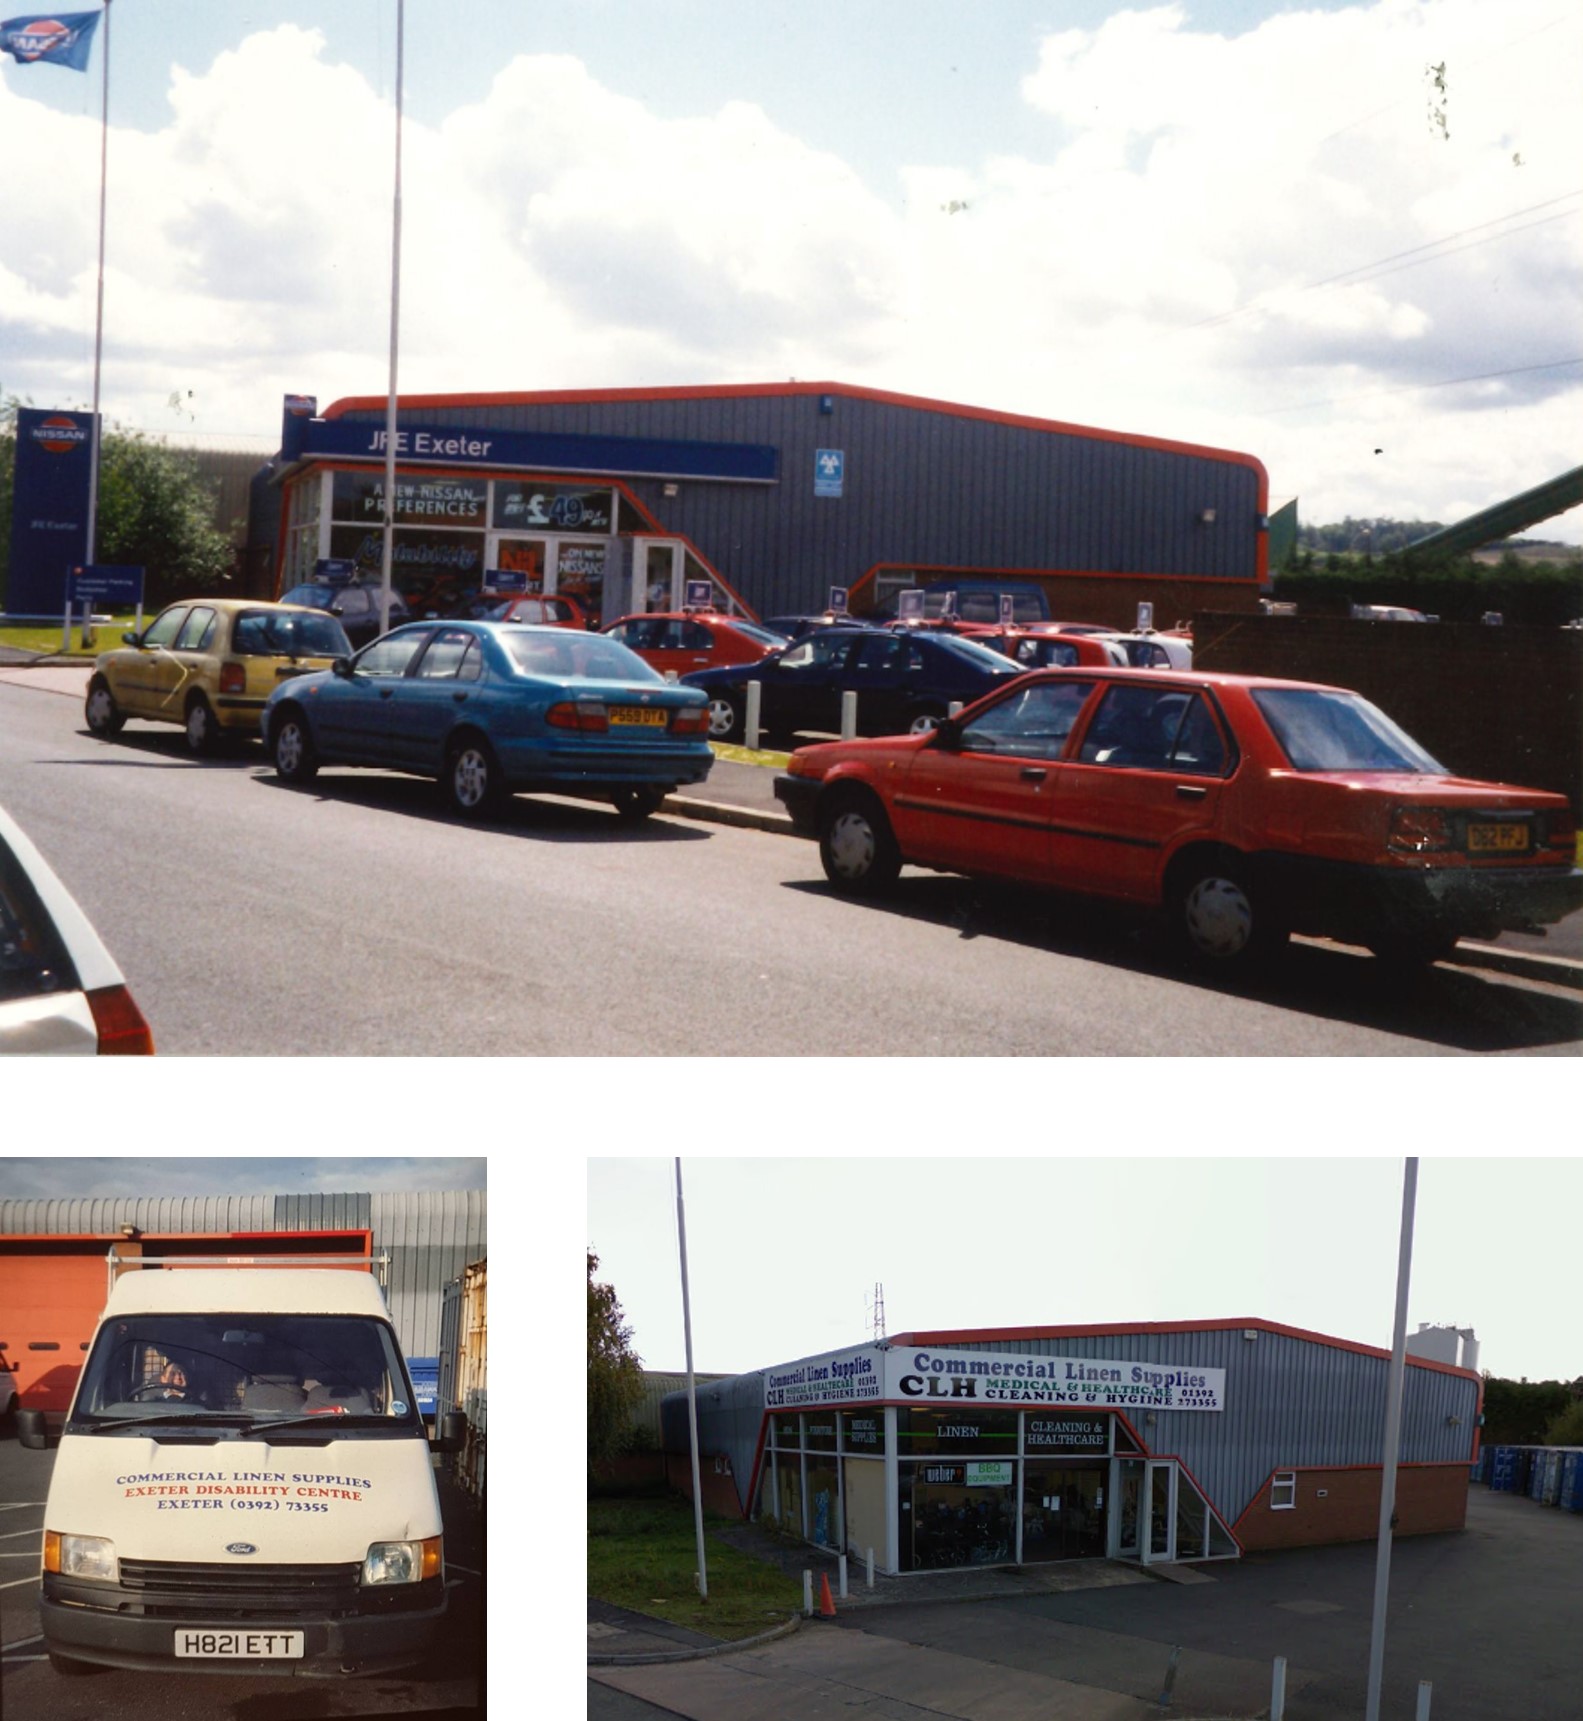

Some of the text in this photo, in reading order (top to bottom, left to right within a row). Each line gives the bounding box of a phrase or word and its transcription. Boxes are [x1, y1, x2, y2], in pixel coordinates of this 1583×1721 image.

[33, 429, 84, 440] NISSAN
[415, 433, 492, 457] Exeter
[421, 486, 474, 500] NISSAN
[365, 498, 478, 517] PRFERENCES
[769, 1356, 872, 1389] Commercial Linen Supplies
[914, 1353, 1206, 1388] Commercial Linen Supplies
[899, 1375, 977, 1398] CLH
[985, 1378, 1060, 1391] MEDICAL
[1081, 1383, 1173, 1397] HEALTHCARE
[1181, 1388, 1214, 1398] 01392
[766, 1389, 784, 1406] CLH
[985, 1389, 1078, 1402] CLEANING
[1085, 1393, 1097, 1402] &
[937, 1426, 979, 1438] LINEN
[1030, 1421, 1102, 1433] CLEANING &
[1028, 1433, 1104, 1445] HEALTHCARE
[927, 1465, 956, 1483] weber
[978, 1463, 1001, 1474] BBQ
[117, 1472, 371, 1489] COMMERCIAL LINEN SUPPLIES
[125, 1485, 362, 1501] EXETER DISABILITY CENTRE
[157, 1499, 328, 1513] EXETER (0392) 73355
[229, 1542, 251, 1554] Ford
[185, 1634, 294, 1655] H821 ETT
